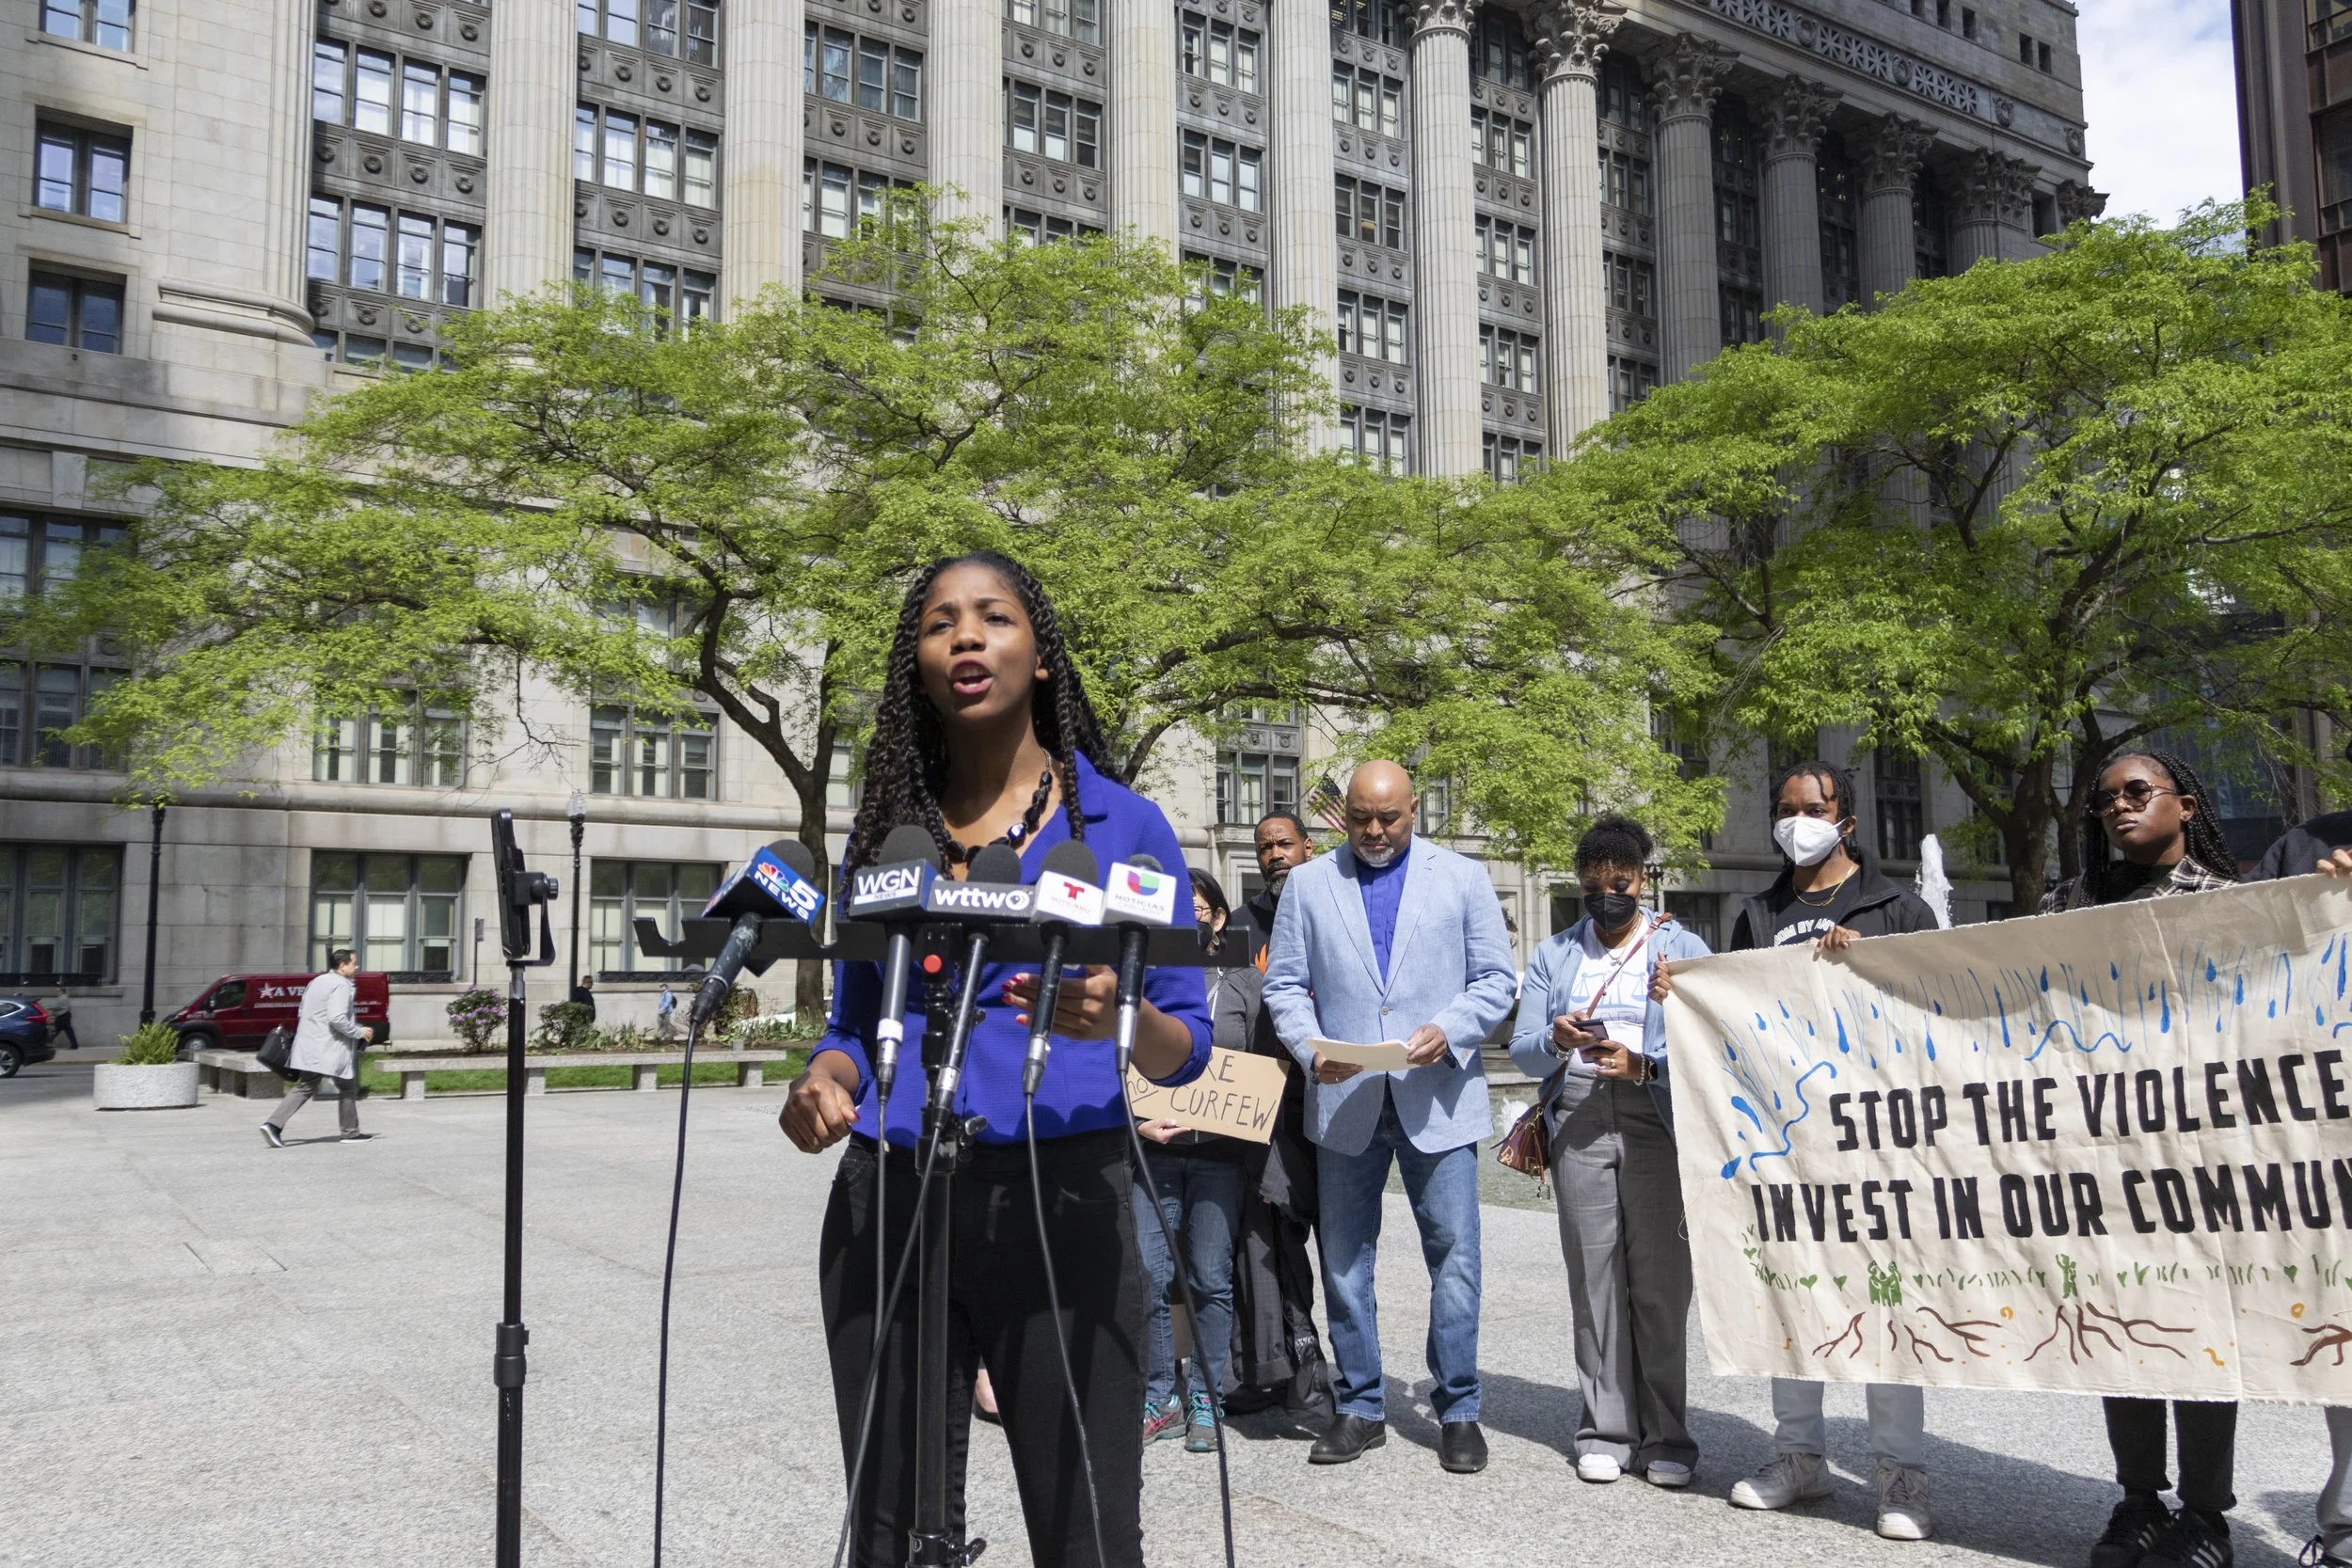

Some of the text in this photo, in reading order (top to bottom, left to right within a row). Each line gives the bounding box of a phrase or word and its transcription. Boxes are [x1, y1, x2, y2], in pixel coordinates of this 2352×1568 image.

[755, 870, 809, 920] NEWS
[789, 879, 819, 911] 5
[857, 865, 921, 895] WGN
[1115, 894, 1165, 911] NOTICIAS
[1797, 919, 1815, 934] BY
[1169, 1085, 1278, 1132] CURFEW
[1829, 1049, 2351, 1152] STOP THE VIOLENCE
[1751, 1179, 1914, 1243] INVEST
[1932, 1176, 1986, 1240] IN
[1999, 1172, 2109, 1239] OUR
